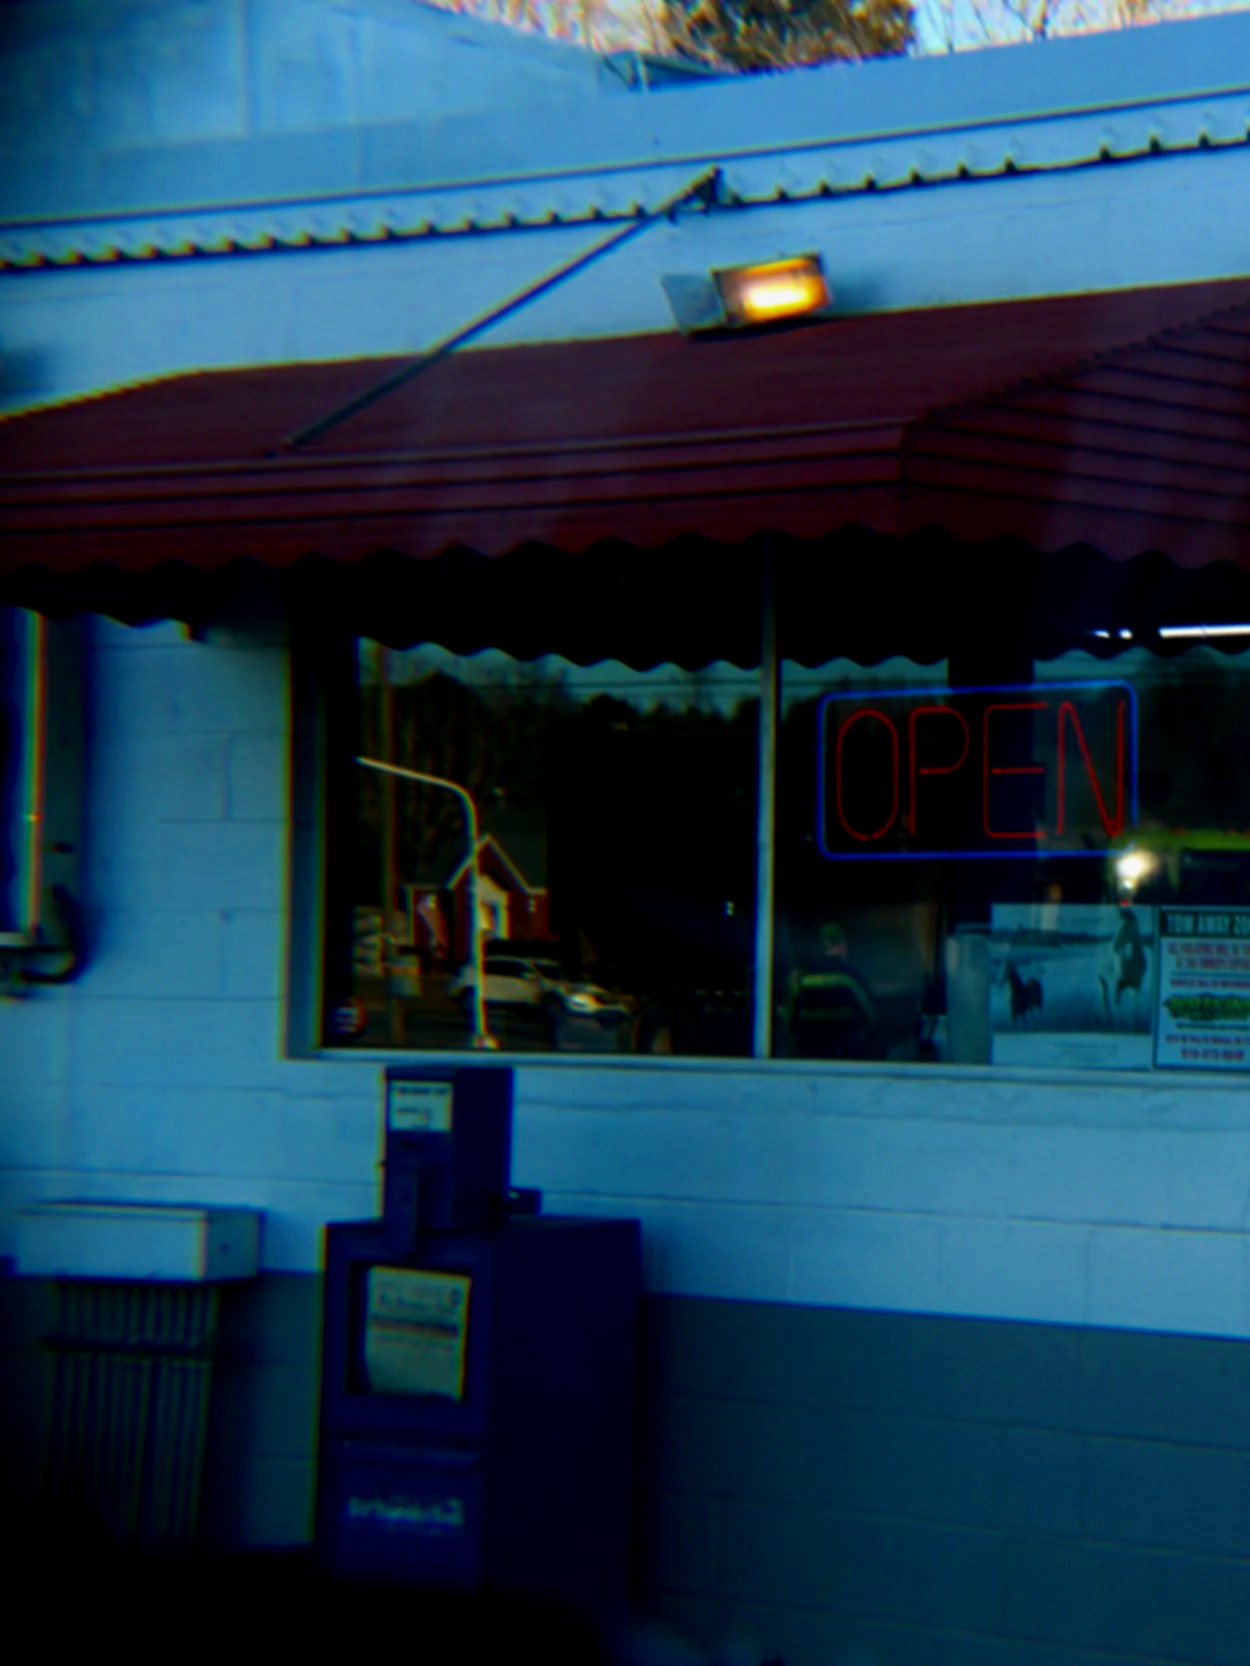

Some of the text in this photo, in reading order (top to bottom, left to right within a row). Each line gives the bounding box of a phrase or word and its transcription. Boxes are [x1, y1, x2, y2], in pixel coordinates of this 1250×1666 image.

[837, 701, 1126, 841] OPEN
[1166, 914, 1194, 935] TOW
[1196, 914, 1230, 935] AWAY
